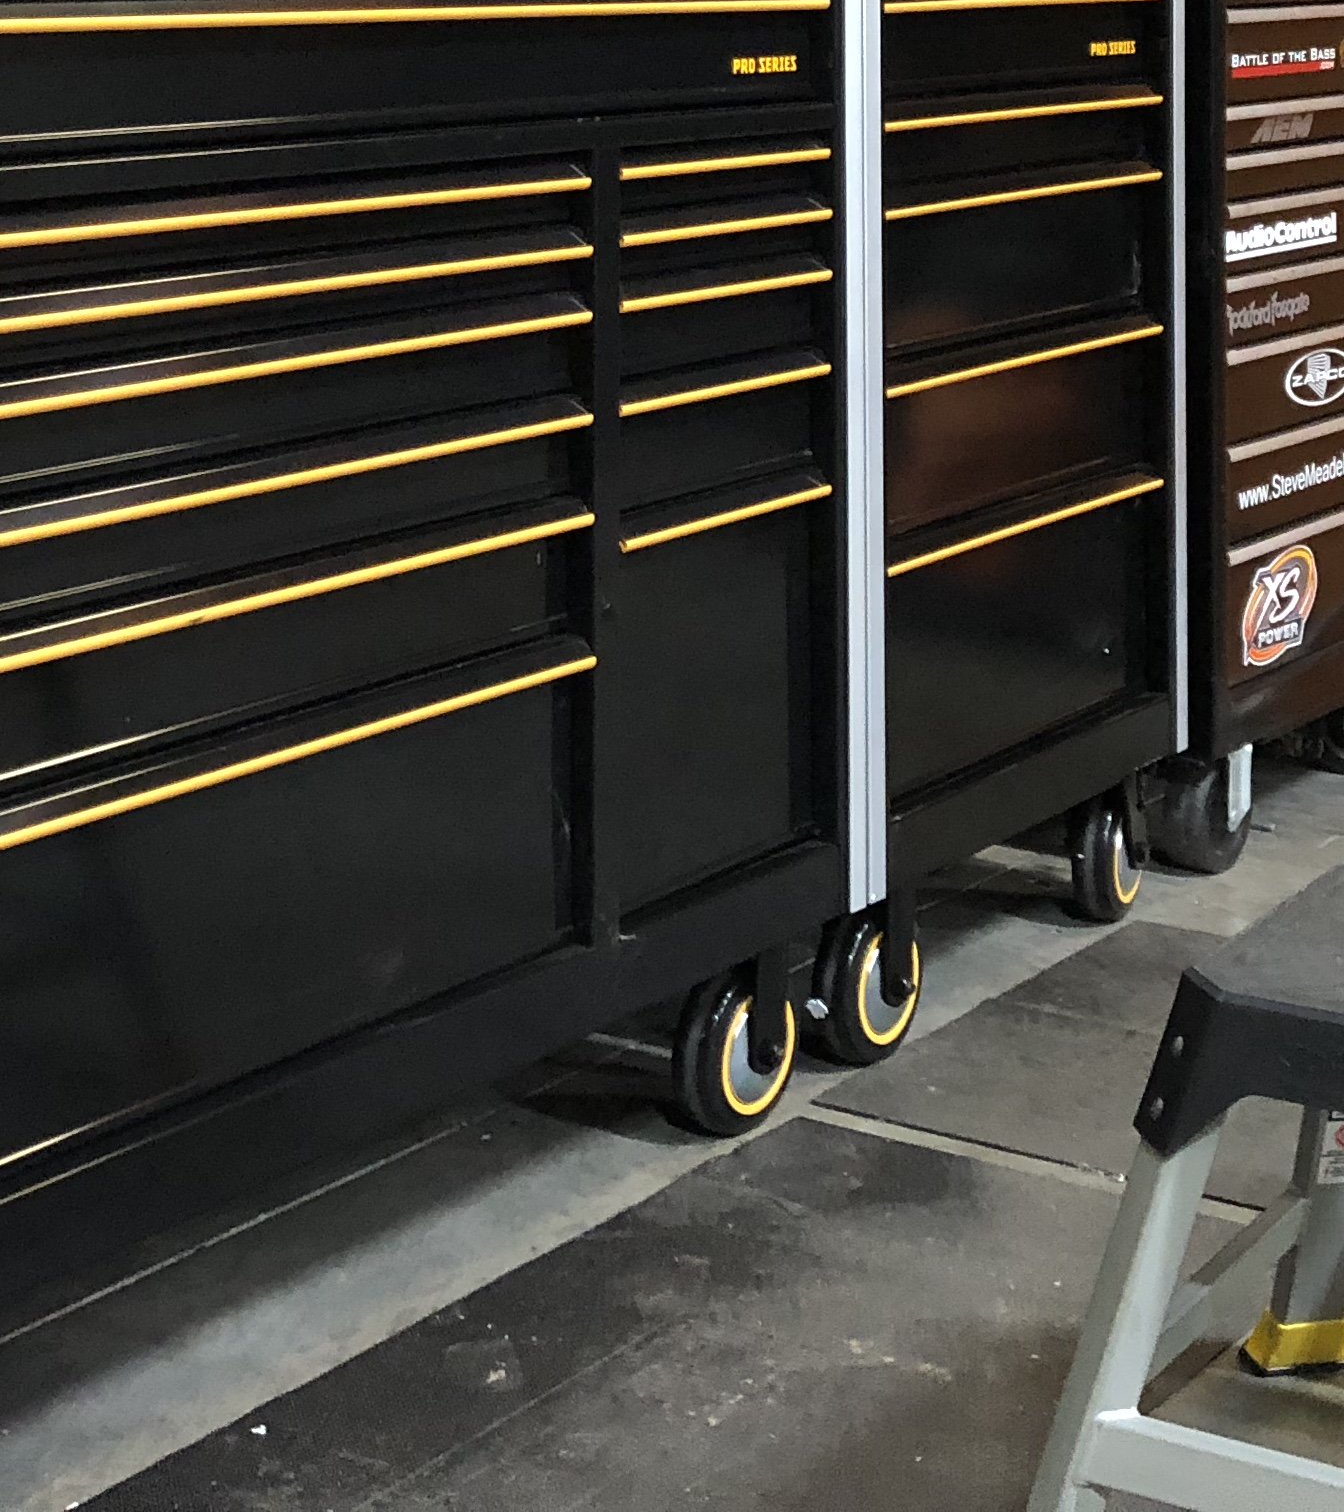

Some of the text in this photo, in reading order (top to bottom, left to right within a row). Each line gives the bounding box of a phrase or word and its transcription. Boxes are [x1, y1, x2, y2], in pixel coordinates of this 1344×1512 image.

[1090, 40, 1137, 57] PRO SERIES
[1231, 47, 1337, 69] BATTLE OF THE BASS
[732, 54, 798, 76] PRO SERIES
[1225, 211, 1337, 254] AudioControl
[1258, 621, 1299, 649] POWER
